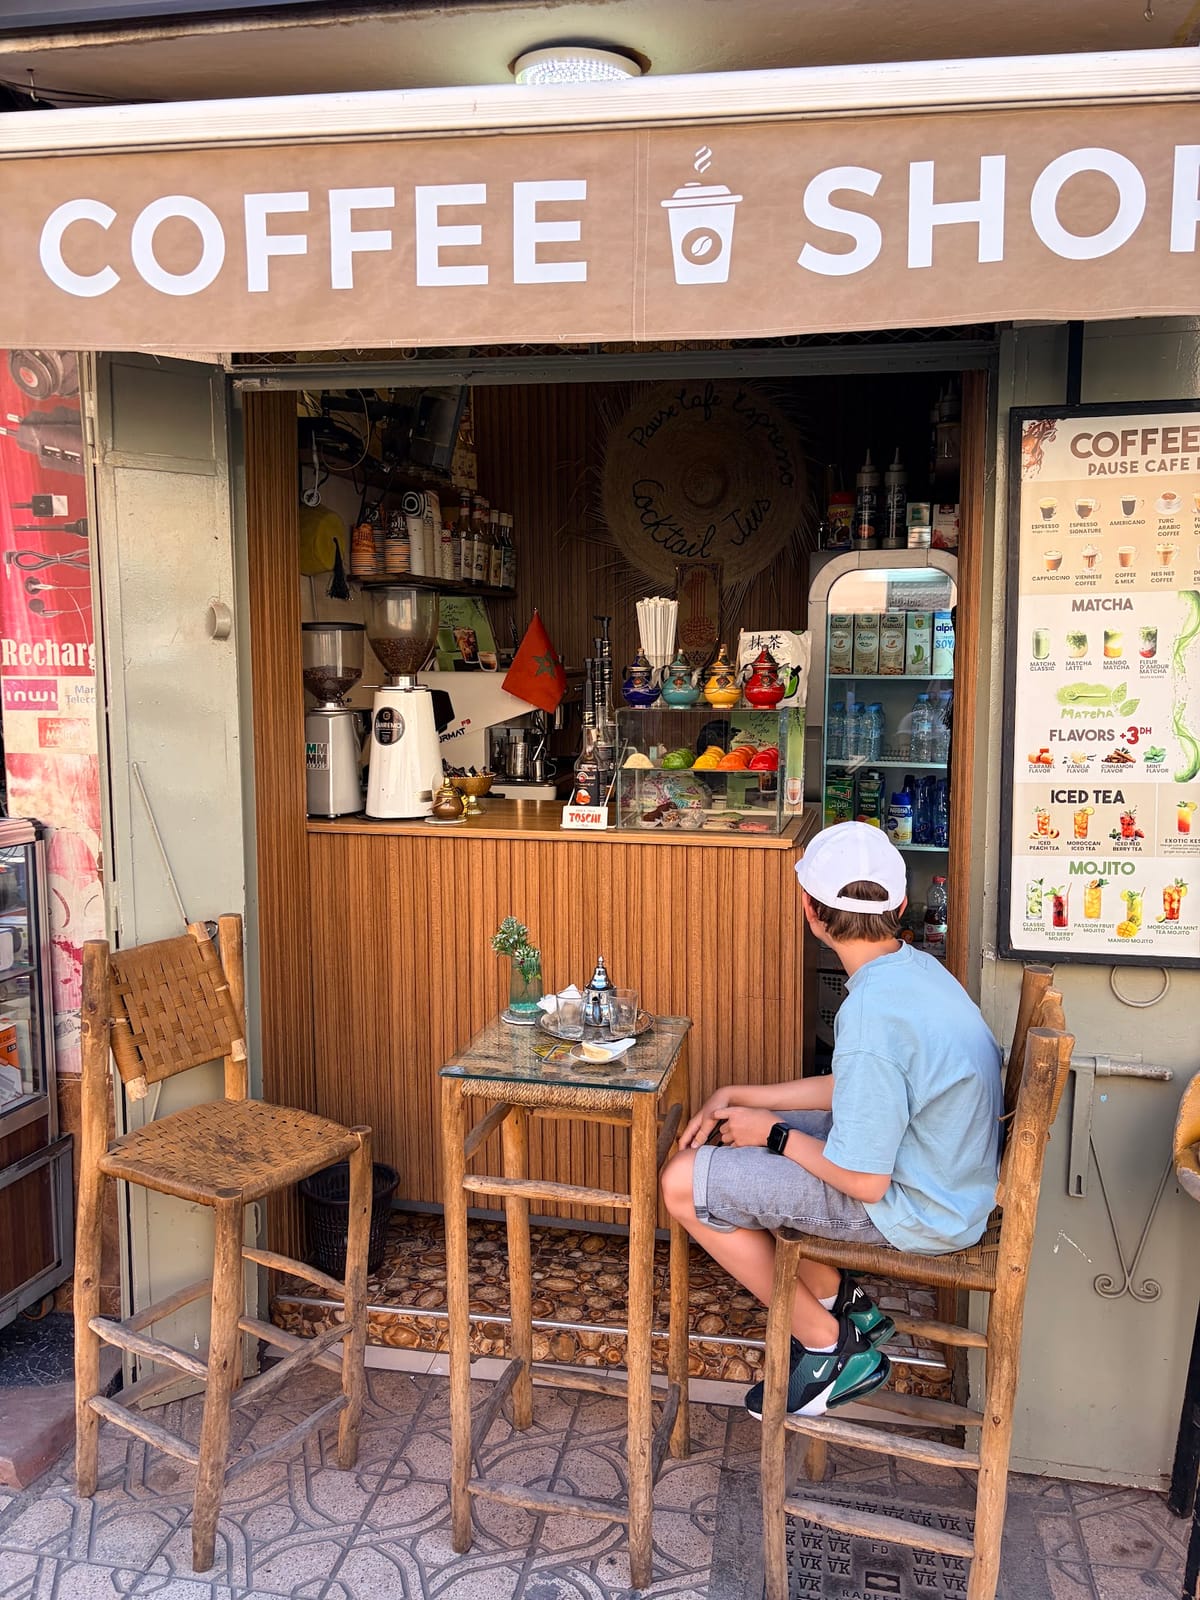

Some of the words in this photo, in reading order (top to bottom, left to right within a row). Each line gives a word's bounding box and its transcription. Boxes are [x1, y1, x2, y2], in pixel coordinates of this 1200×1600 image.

[39, 180, 587, 297] COFFEE
[1070, 426, 1200, 458] COFFEE
[1088, 461, 1139, 476] PAUSE
[1145, 458, 1190, 472] CAFE
[1072, 598, 1133, 612] MATCHA
[936, 623, 954, 633] alpr
[748, 634, 783, 650] 抹茶
[74, 685, 96, 694] Mar
[1050, 729, 1115, 742] FLAVORS
[1051, 790, 1088, 804] ICED
[1093, 790, 1125, 804] TEA
[569, 813, 601, 824] TOSCHI
[1069, 861, 1135, 875] MOJITO
[939, 1518, 961, 1530] VK
[802, 1537, 823, 1550] VK
[829, 1541, 851, 1554] VK
[800, 1556, 822, 1570] VK
[914, 1553, 936, 1567] VK
[942, 1557, 963, 1570] VK
[828, 1561, 850, 1574] VK
[799, 1578, 821, 1592] VK
[914, 1573, 937, 1587] VK
[944, 1578, 966, 1592] VK
